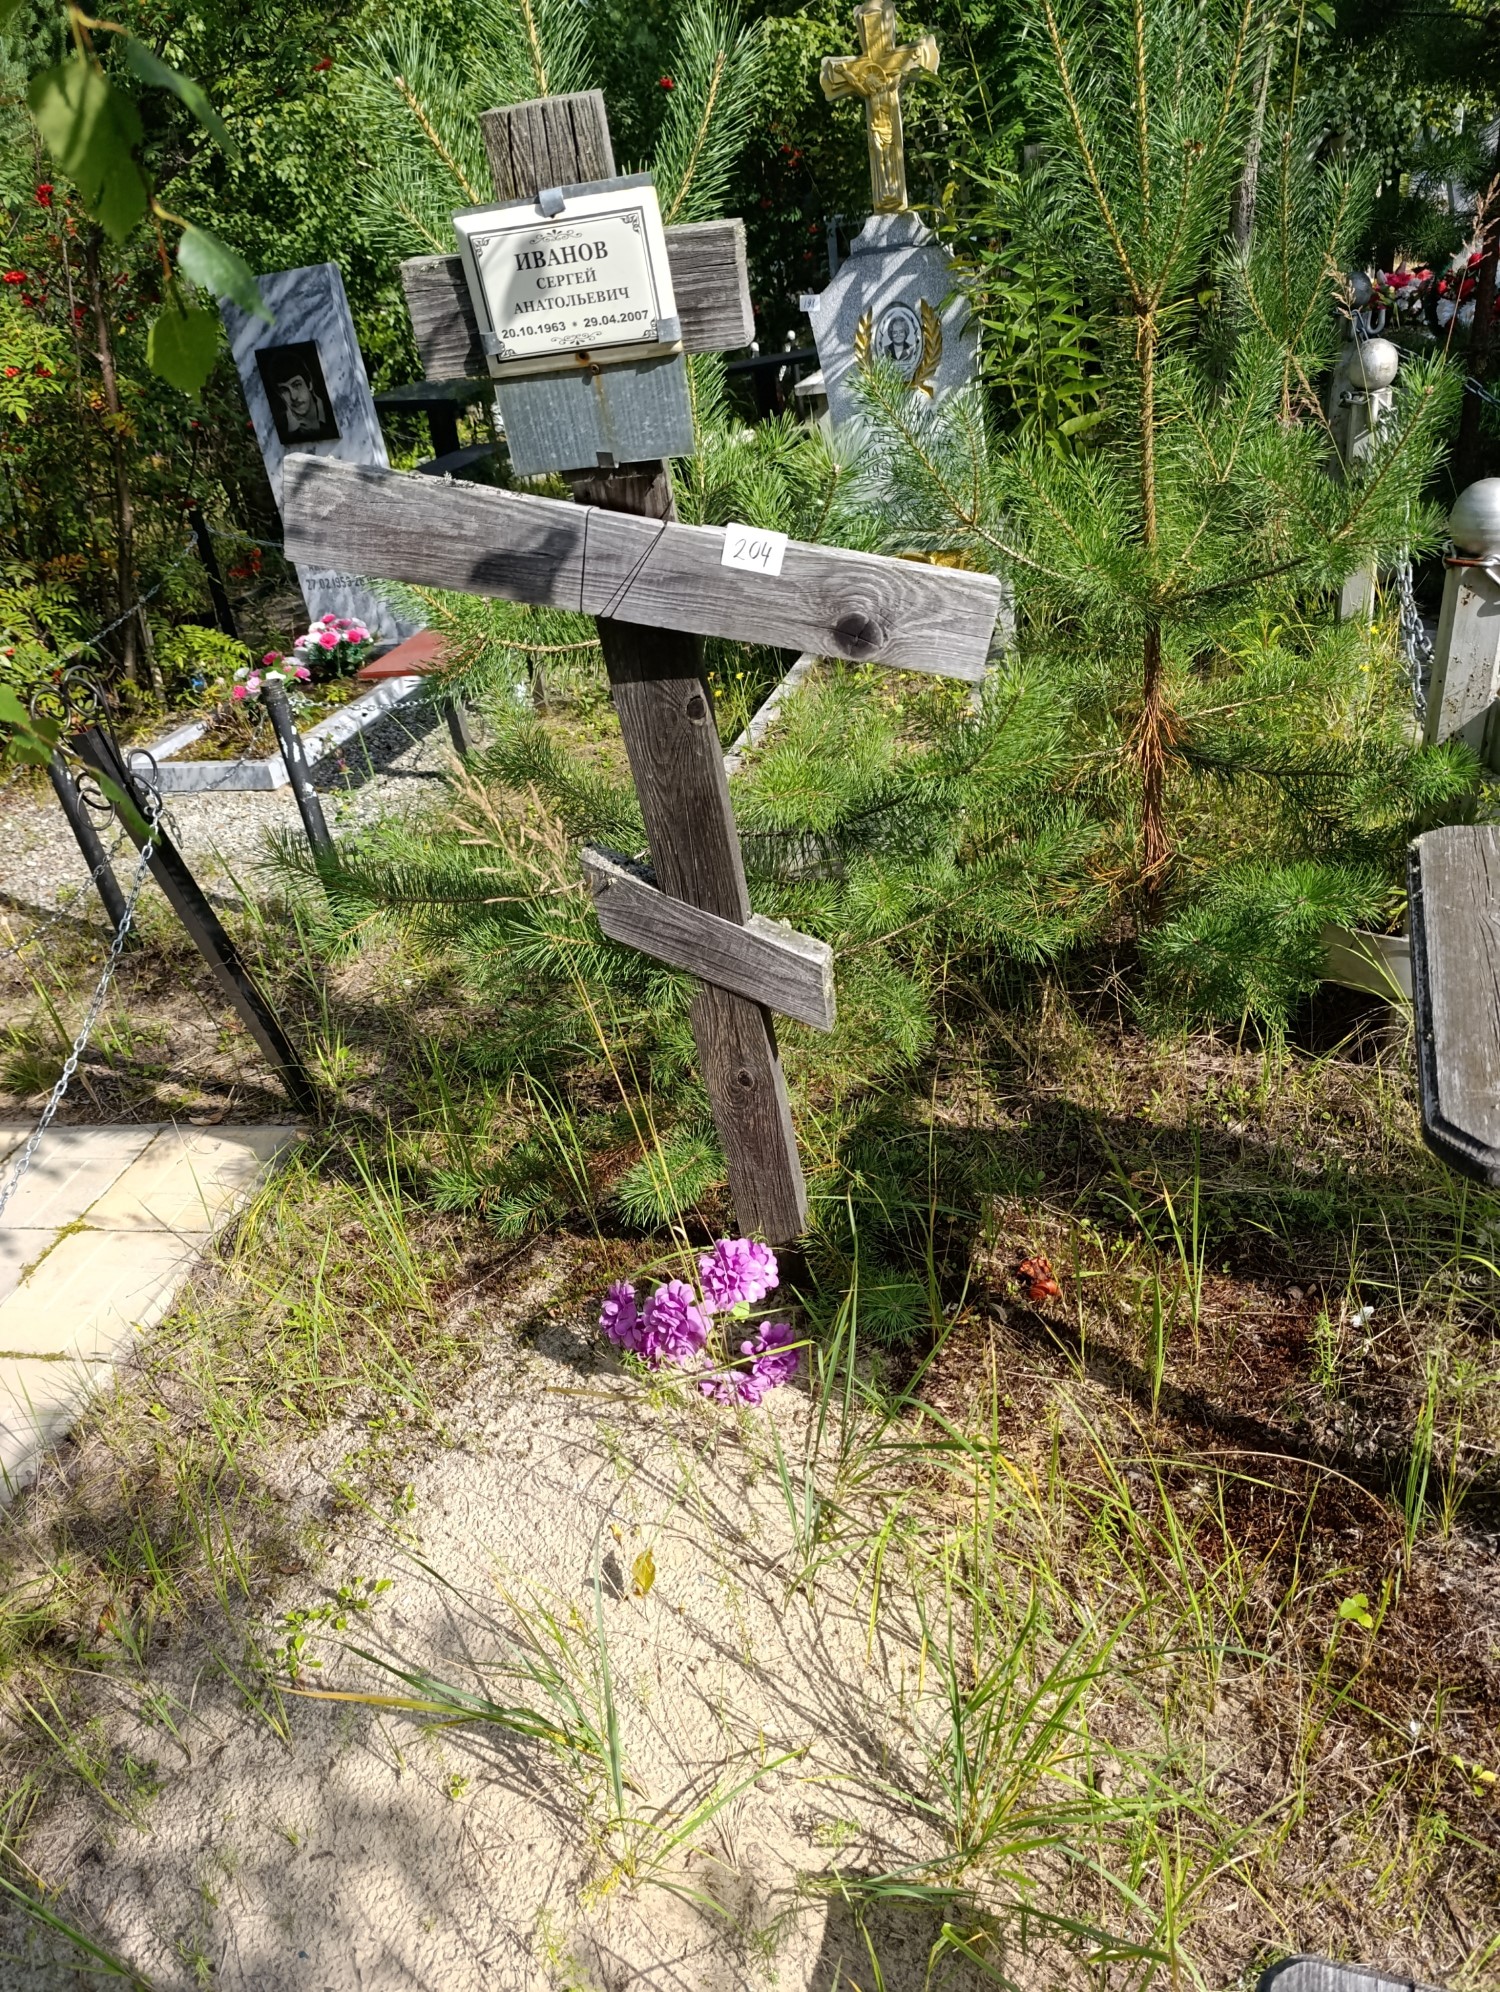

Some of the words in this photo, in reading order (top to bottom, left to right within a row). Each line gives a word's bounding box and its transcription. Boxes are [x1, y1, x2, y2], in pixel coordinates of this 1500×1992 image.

[514, 240, 608, 271] ИВАНОВ
[536, 267, 597, 290] СЕРГЕЙ
[513, 286, 630, 315] АНАТОЛЬЕВИЧ
[502, 320, 567, 339] 20.10.1963
[583, 309, 649, 328] 29.04.2007
[733, 538, 772, 567] 204
